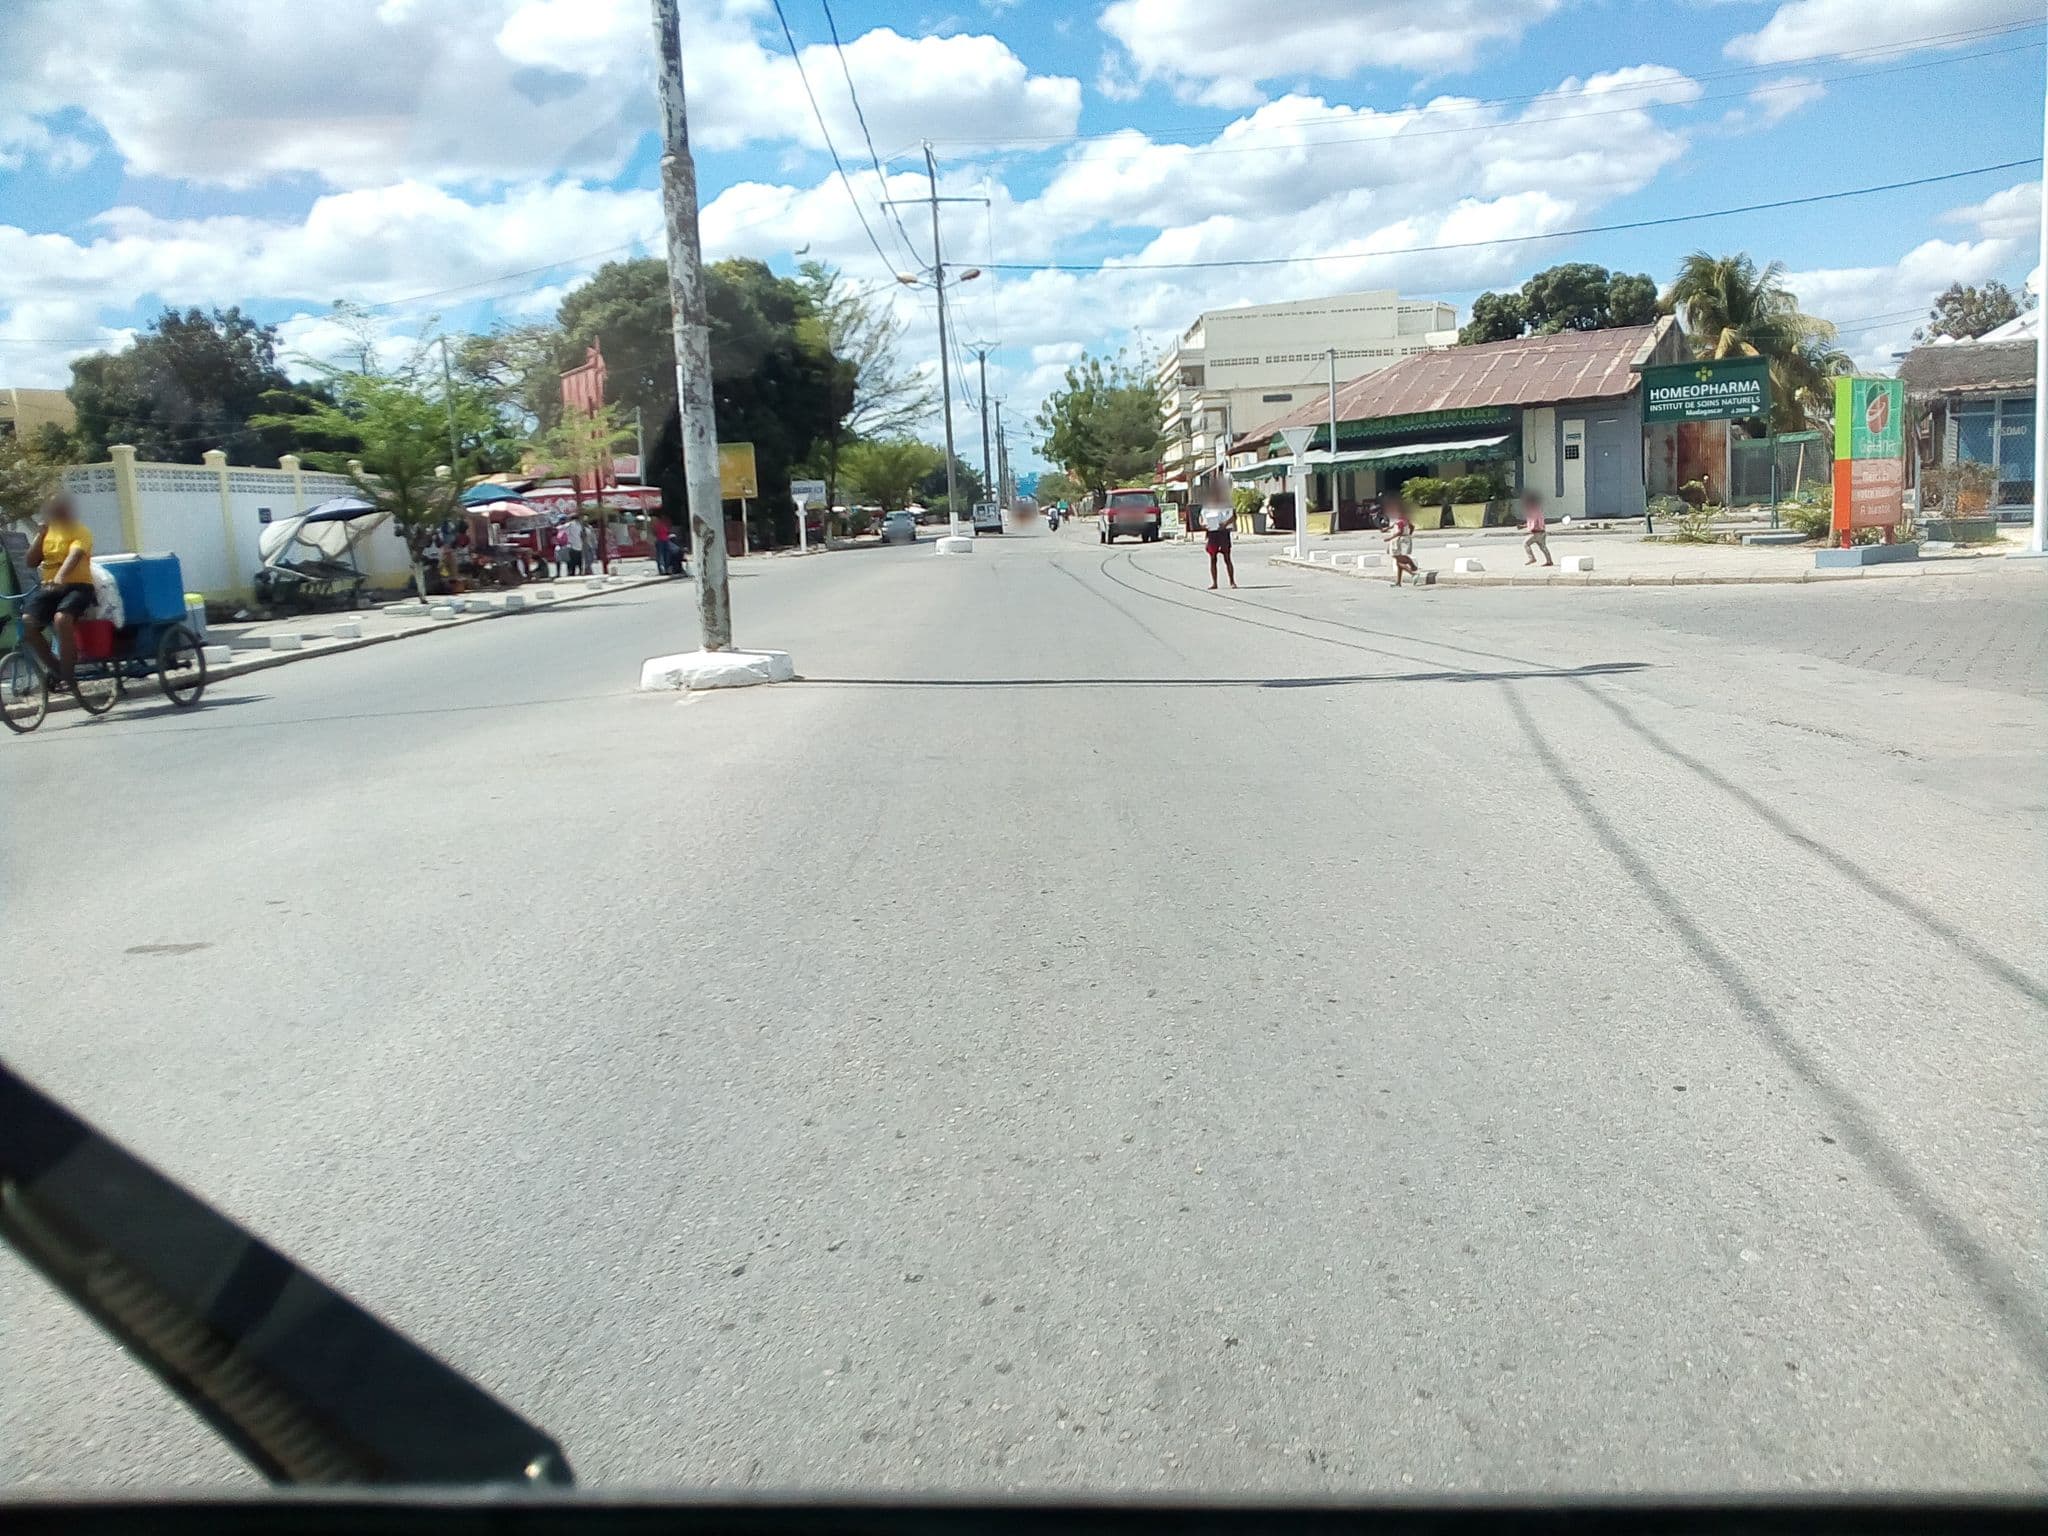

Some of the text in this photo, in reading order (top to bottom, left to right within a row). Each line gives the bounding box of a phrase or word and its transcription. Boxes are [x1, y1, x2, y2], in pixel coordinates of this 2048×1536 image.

[1650, 380, 1760, 400] HOMEOPHARMA
[1649, 396, 1760, 412] INSTITUT DE SOINS NATURELS
